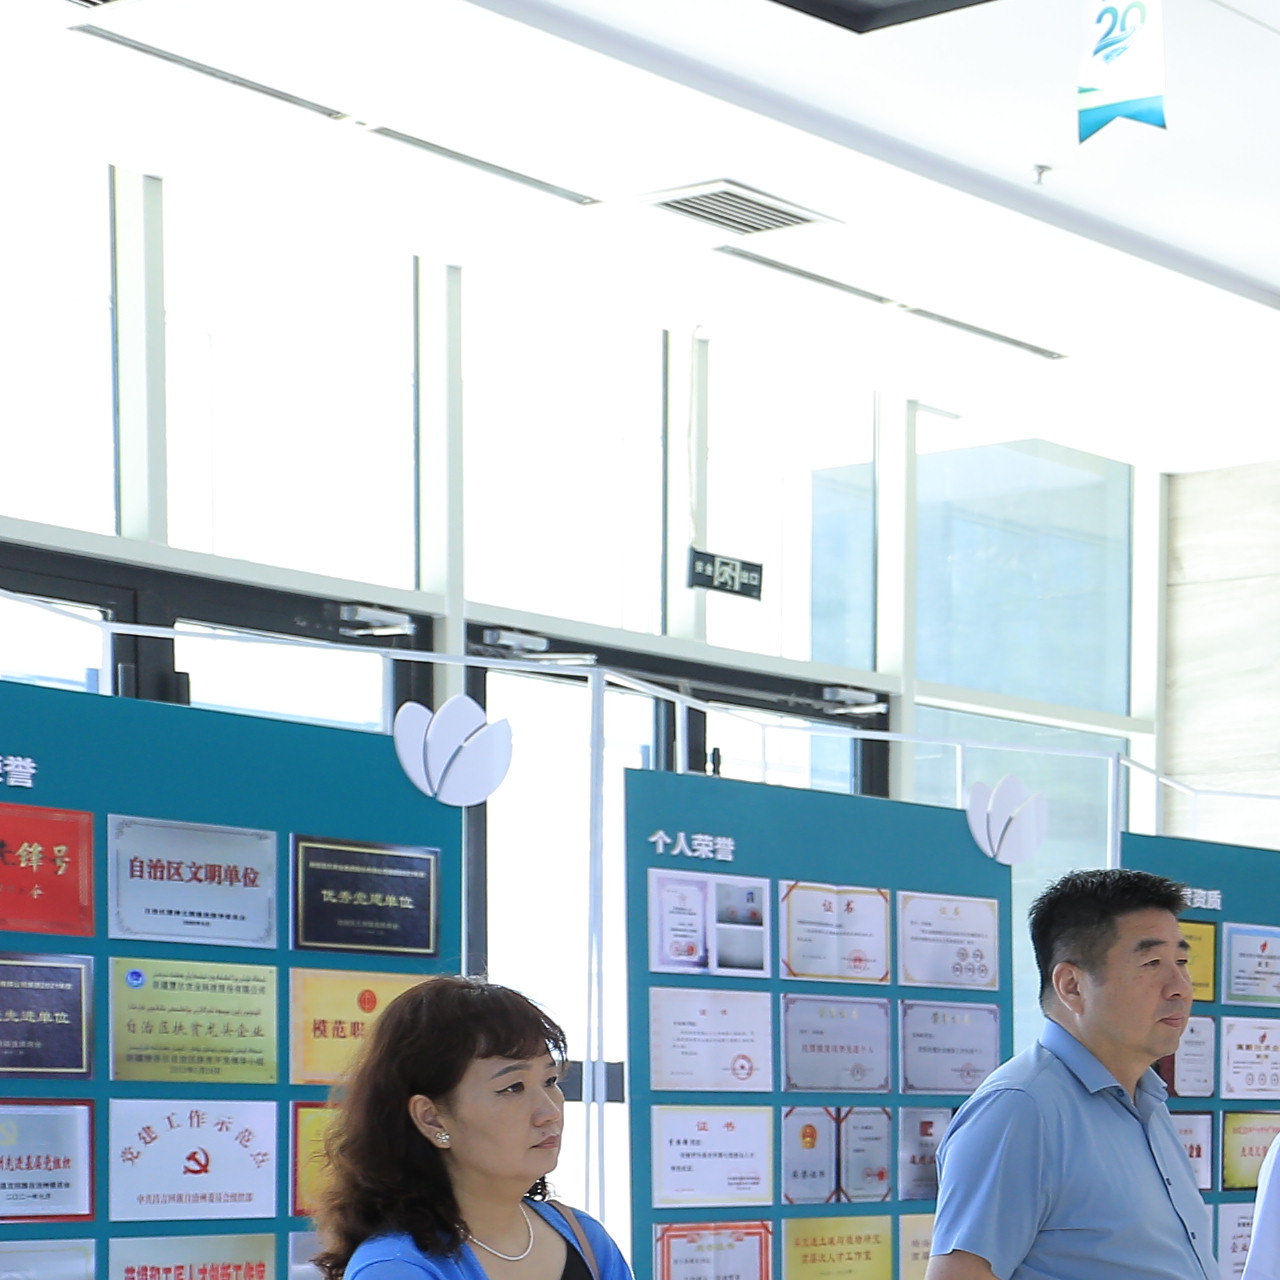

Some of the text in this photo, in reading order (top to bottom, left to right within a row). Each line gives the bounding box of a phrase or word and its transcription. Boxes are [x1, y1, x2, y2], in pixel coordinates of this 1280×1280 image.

[0, 755, 38, 788] 誉
[648, 829, 736, 862] 个人荣誉
[129, 855, 261, 888] 自治区文明单位
[0, 1009, 71, 1024] 先进单位
[696, 1121, 736, 1132] 证书
